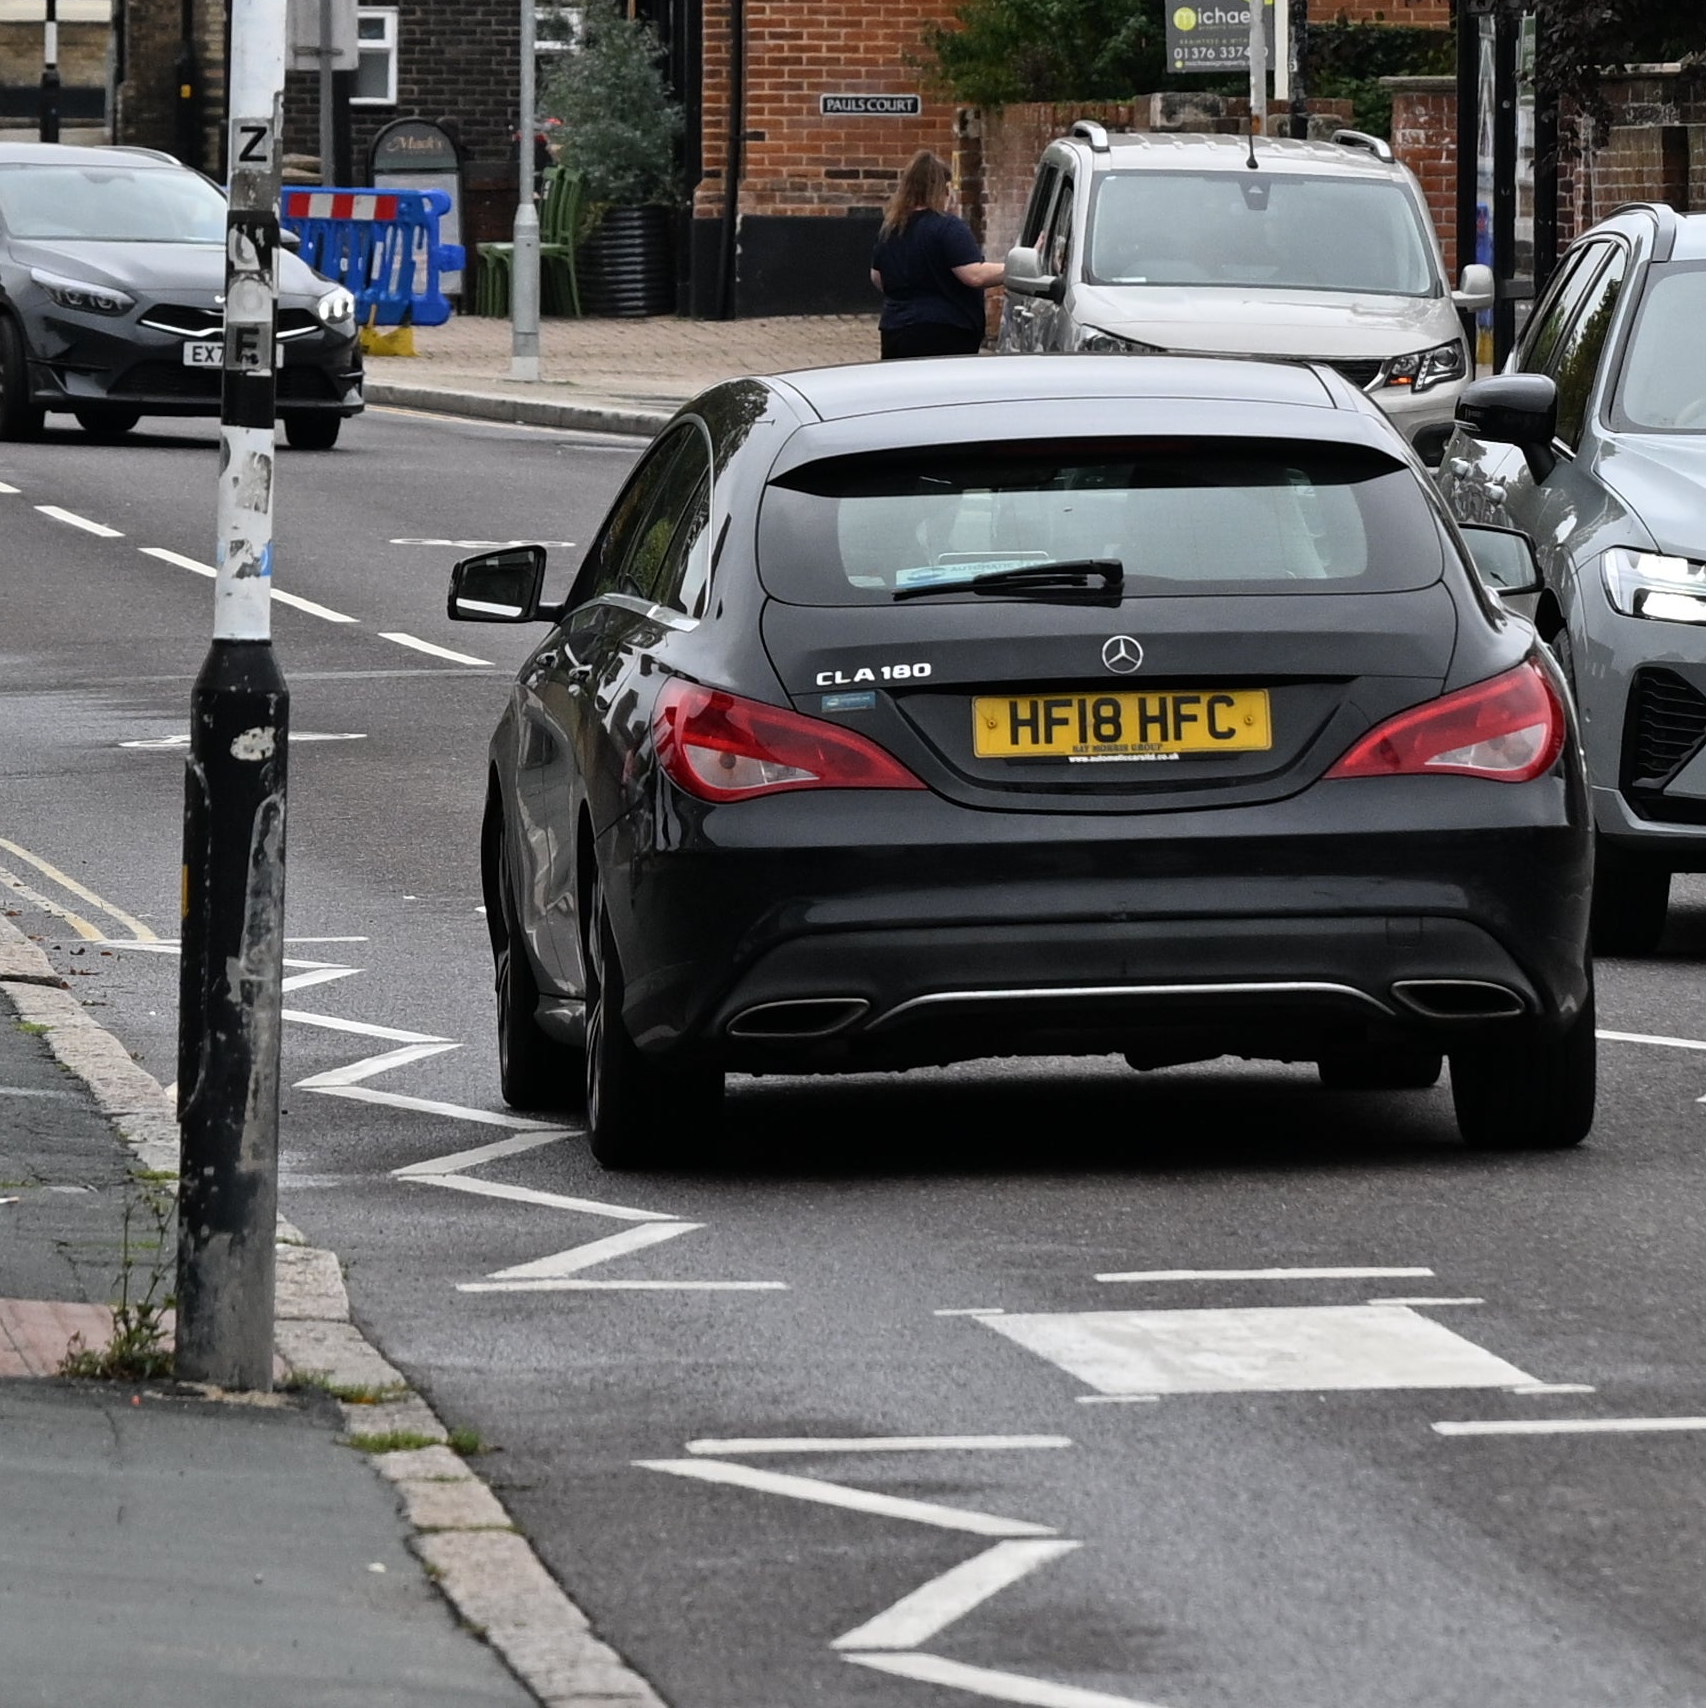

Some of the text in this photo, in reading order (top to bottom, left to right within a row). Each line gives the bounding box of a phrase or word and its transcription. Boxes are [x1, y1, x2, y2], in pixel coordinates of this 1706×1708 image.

[1173, 6, 1251, 29] michae
[1174, 47, 1216, 60] 01376
[826, 99, 913, 111] PAULS COURT
[239, 126, 267, 162] Z
[192, 345, 224, 363] EX7
[816, 663, 931, 685] CLA 180
[1009, 695, 1236, 745] HF18 HFC
